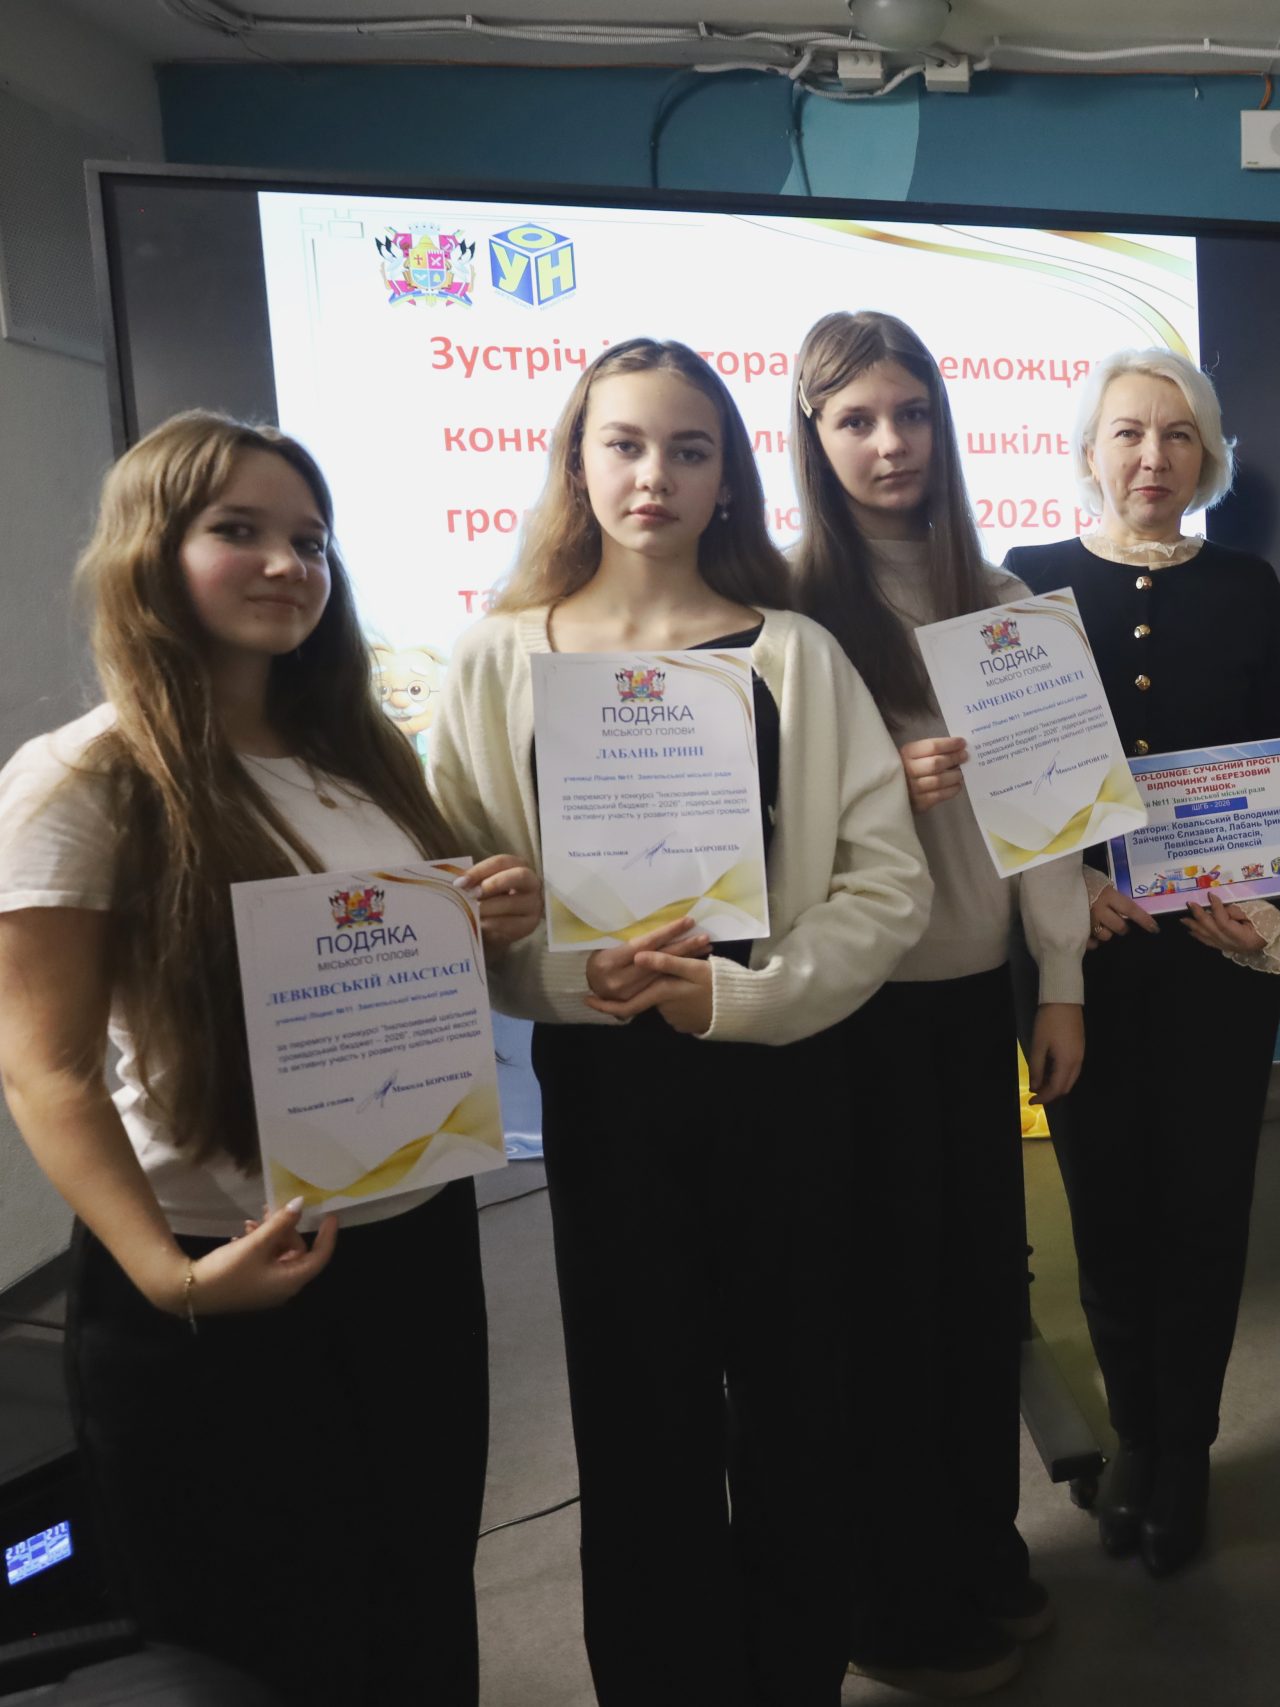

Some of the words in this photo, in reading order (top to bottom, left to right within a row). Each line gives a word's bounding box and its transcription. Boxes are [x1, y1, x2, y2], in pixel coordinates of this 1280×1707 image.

[430, 336, 589, 380] Зустріч
[975, 499, 1062, 529] 2026
[980, 645, 1048, 675] ПОДЯКА
[985, 671, 1022, 687] МІСЬКОГО
[1023, 662, 1052, 676] ГОЛОВИ
[966, 689, 1024, 713] ЗАЙЧЕНКО
[1026, 670, 1084, 695] ЄЛИЗАВЕТІ
[602, 705, 694, 725] ПОДЯКА
[602, 728, 652, 737] МІСЬКОГО
[655, 727, 695, 736] ГОЛОВИ
[596, 748, 658, 759] ЛАБАНЬ
[663, 746, 703, 757] ІРИНІ
[1134, 769, 1191, 782] CO-LOUNGE:
[1193, 761, 1244, 775] СУЧАСНИЙ
[1147, 776, 1207, 791] ВІДПОЧИНКУ
[1211, 767, 1271, 782] «БЕРЕЗОВИЙ
[1185, 782, 1236, 795] ЗАТИШОК»
[1214, 800, 1231, 808] 2026
[1133, 833, 1175, 845] Зайченко
[1229, 820, 1262, 831] Лабань
[1172, 815, 1231, 830] Ковальський
[1164, 838, 1214, 850] Левківська
[1167, 844, 1225, 860] Грозовський
[1227, 838, 1262, 850] Олексій
[316, 925, 417, 956] ПОДЯКА
[317, 955, 373, 972] МІСЬКОГО
[376, 948, 419, 962] ГОЛОВИ
[266, 975, 381, 1006] ЛЕВКІВСЬКІЙ
[388, 960, 470, 984] АНАСТАСІЇ
